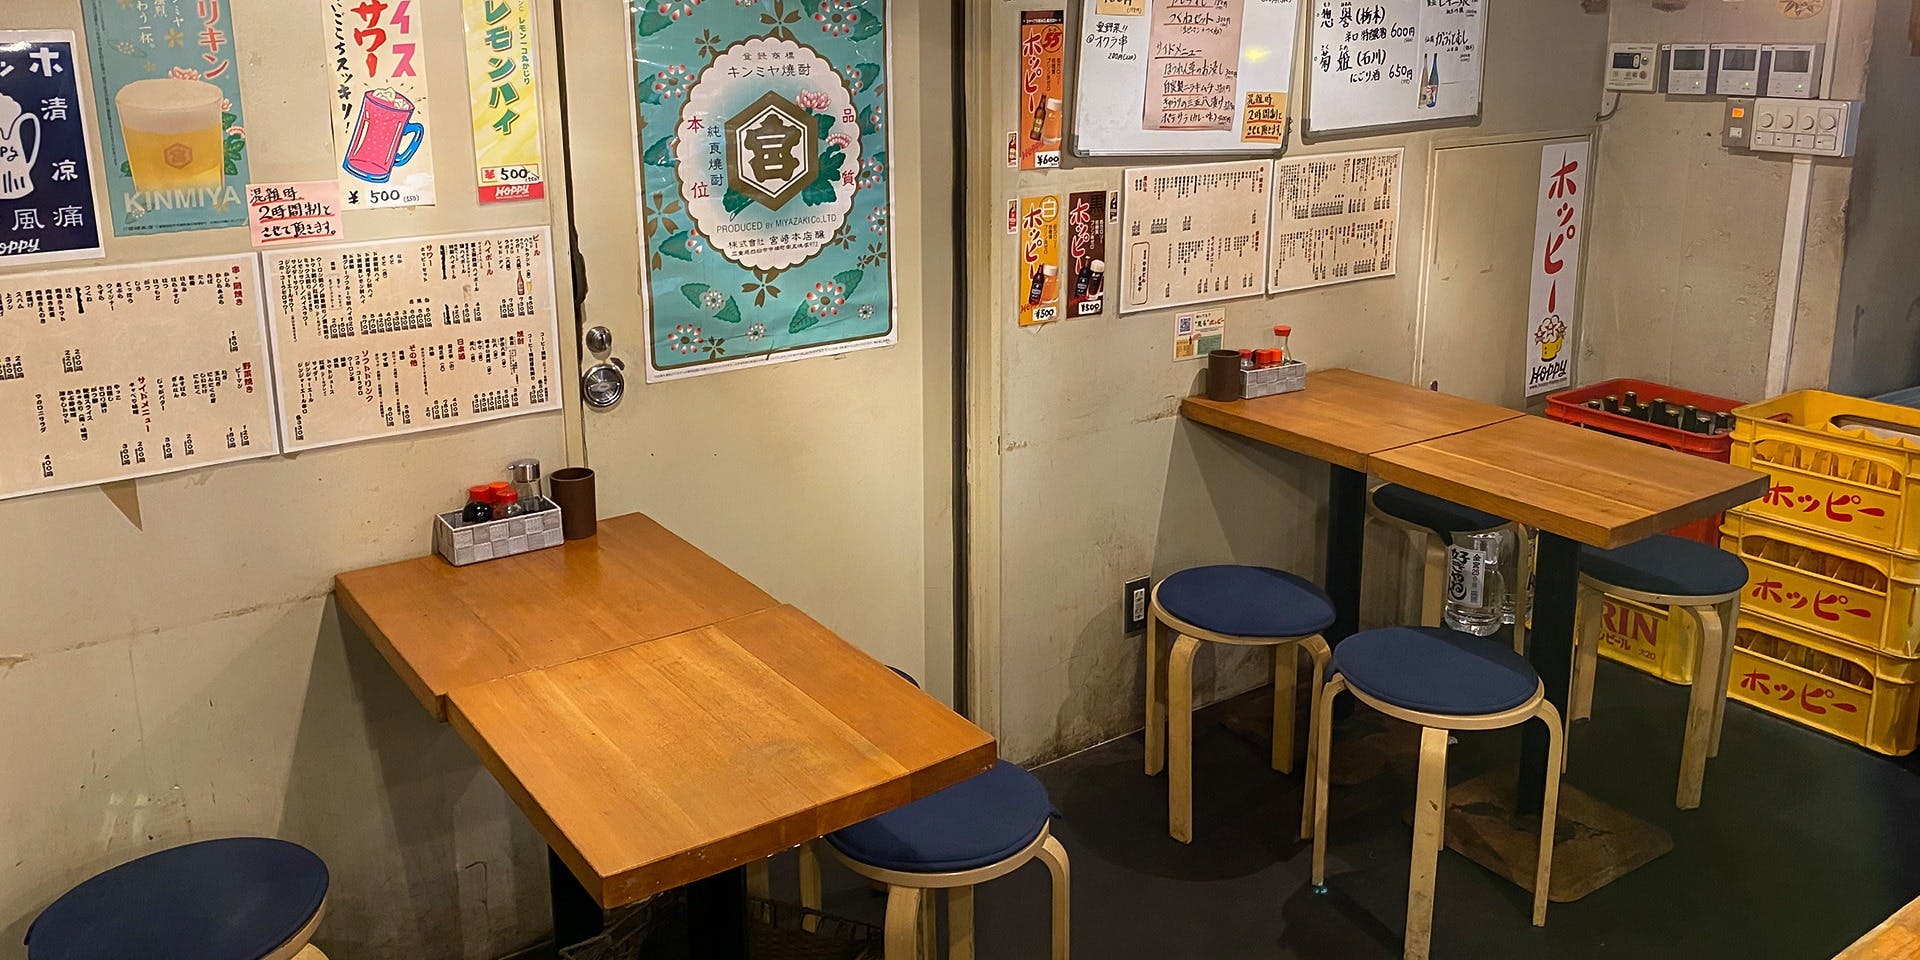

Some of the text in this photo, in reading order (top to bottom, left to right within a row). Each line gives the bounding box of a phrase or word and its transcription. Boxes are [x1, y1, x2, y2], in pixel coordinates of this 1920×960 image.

[350, 0, 389, 78] サワー
[1390, 22, 1415, 38] 600円
[484, 0, 520, 136] レモンハイ
[1022, 27, 1044, 114] ホッピー
[1388, 64, 1413, 81] 650円
[500, 168, 527, 181] 500
[1037, 154, 1060, 167] ¥600
[124, 185, 242, 213] KINMIYA
[370, 189, 401, 204] 500
[258, 202, 332, 221] 2時間制と
[716, 222, 763, 235] PRODUCED
[1023, 202, 1044, 280] ホッピー
[1069, 198, 1091, 276] ホッピー
[1543, 150, 1580, 313] ホッピー
[426, 244, 434, 267] サワー
[484, 240, 494, 276] ハイボール
[532, 234, 541, 256] ビール
[409, 344, 418, 367] その他
[457, 338, 466, 361] 日本酒
[361, 349, 374, 403] ソフトドリンク
[1529, 359, 1569, 385] Hoppy
[136, 376, 151, 433] サイドメニュー
[1762, 480, 1886, 523] ホッピー
[1751, 575, 1872, 621] ホッピー
[1740, 668, 1858, 716] ホッピー
